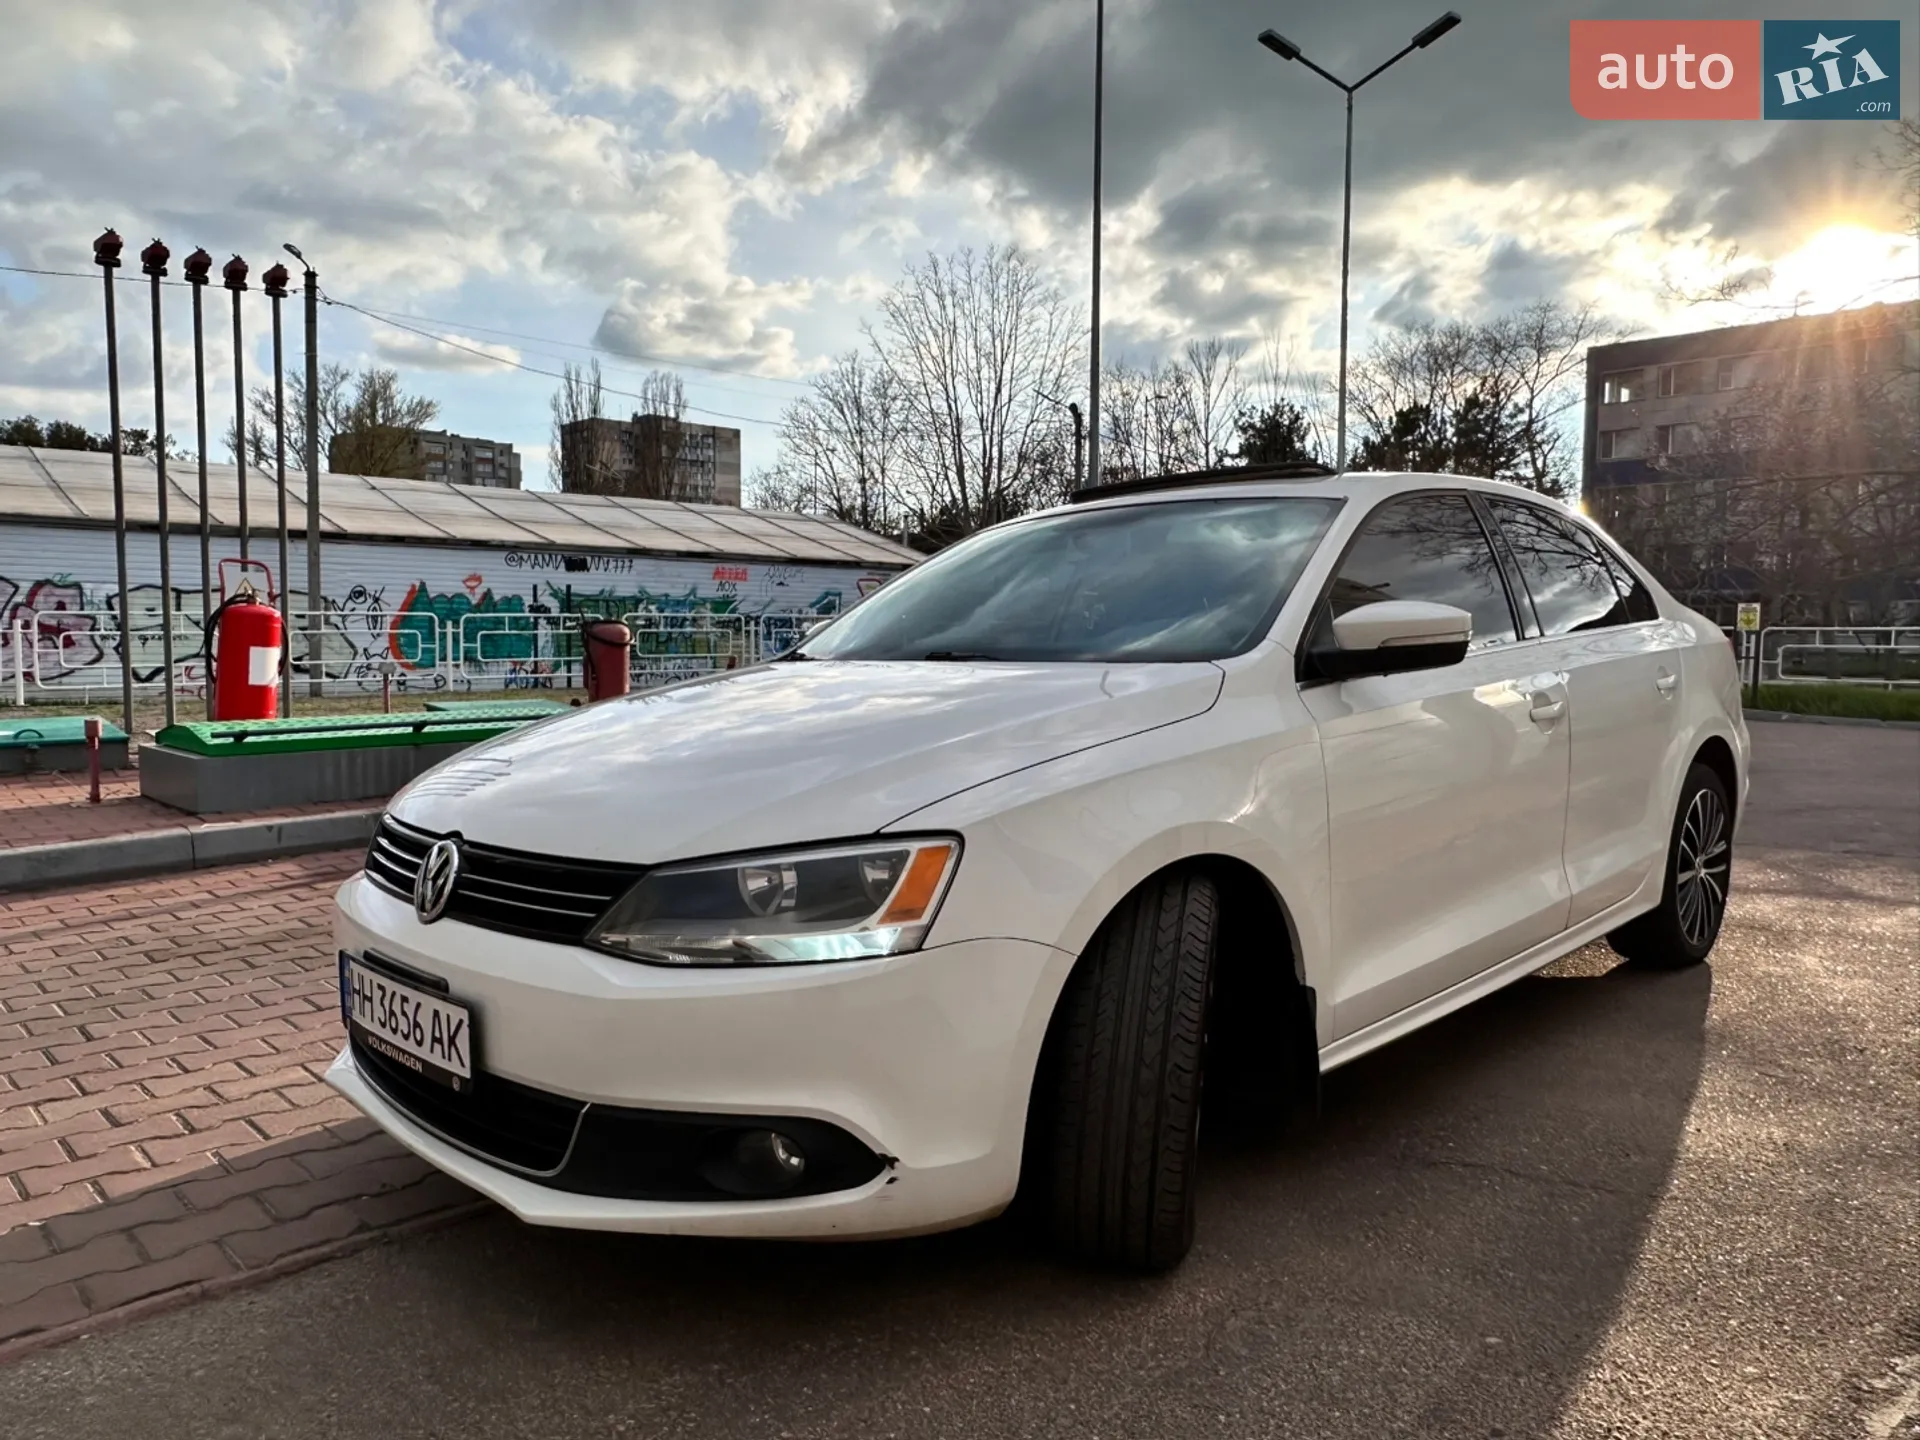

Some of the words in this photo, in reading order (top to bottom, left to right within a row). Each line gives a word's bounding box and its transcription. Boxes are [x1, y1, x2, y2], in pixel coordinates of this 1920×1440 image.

[350, 968, 374, 1023] HH
[376, 982, 425, 1048] 3656
[430, 1008, 466, 1069] AK
[367, 1035, 423, 1073] VOLKSWAGEN
